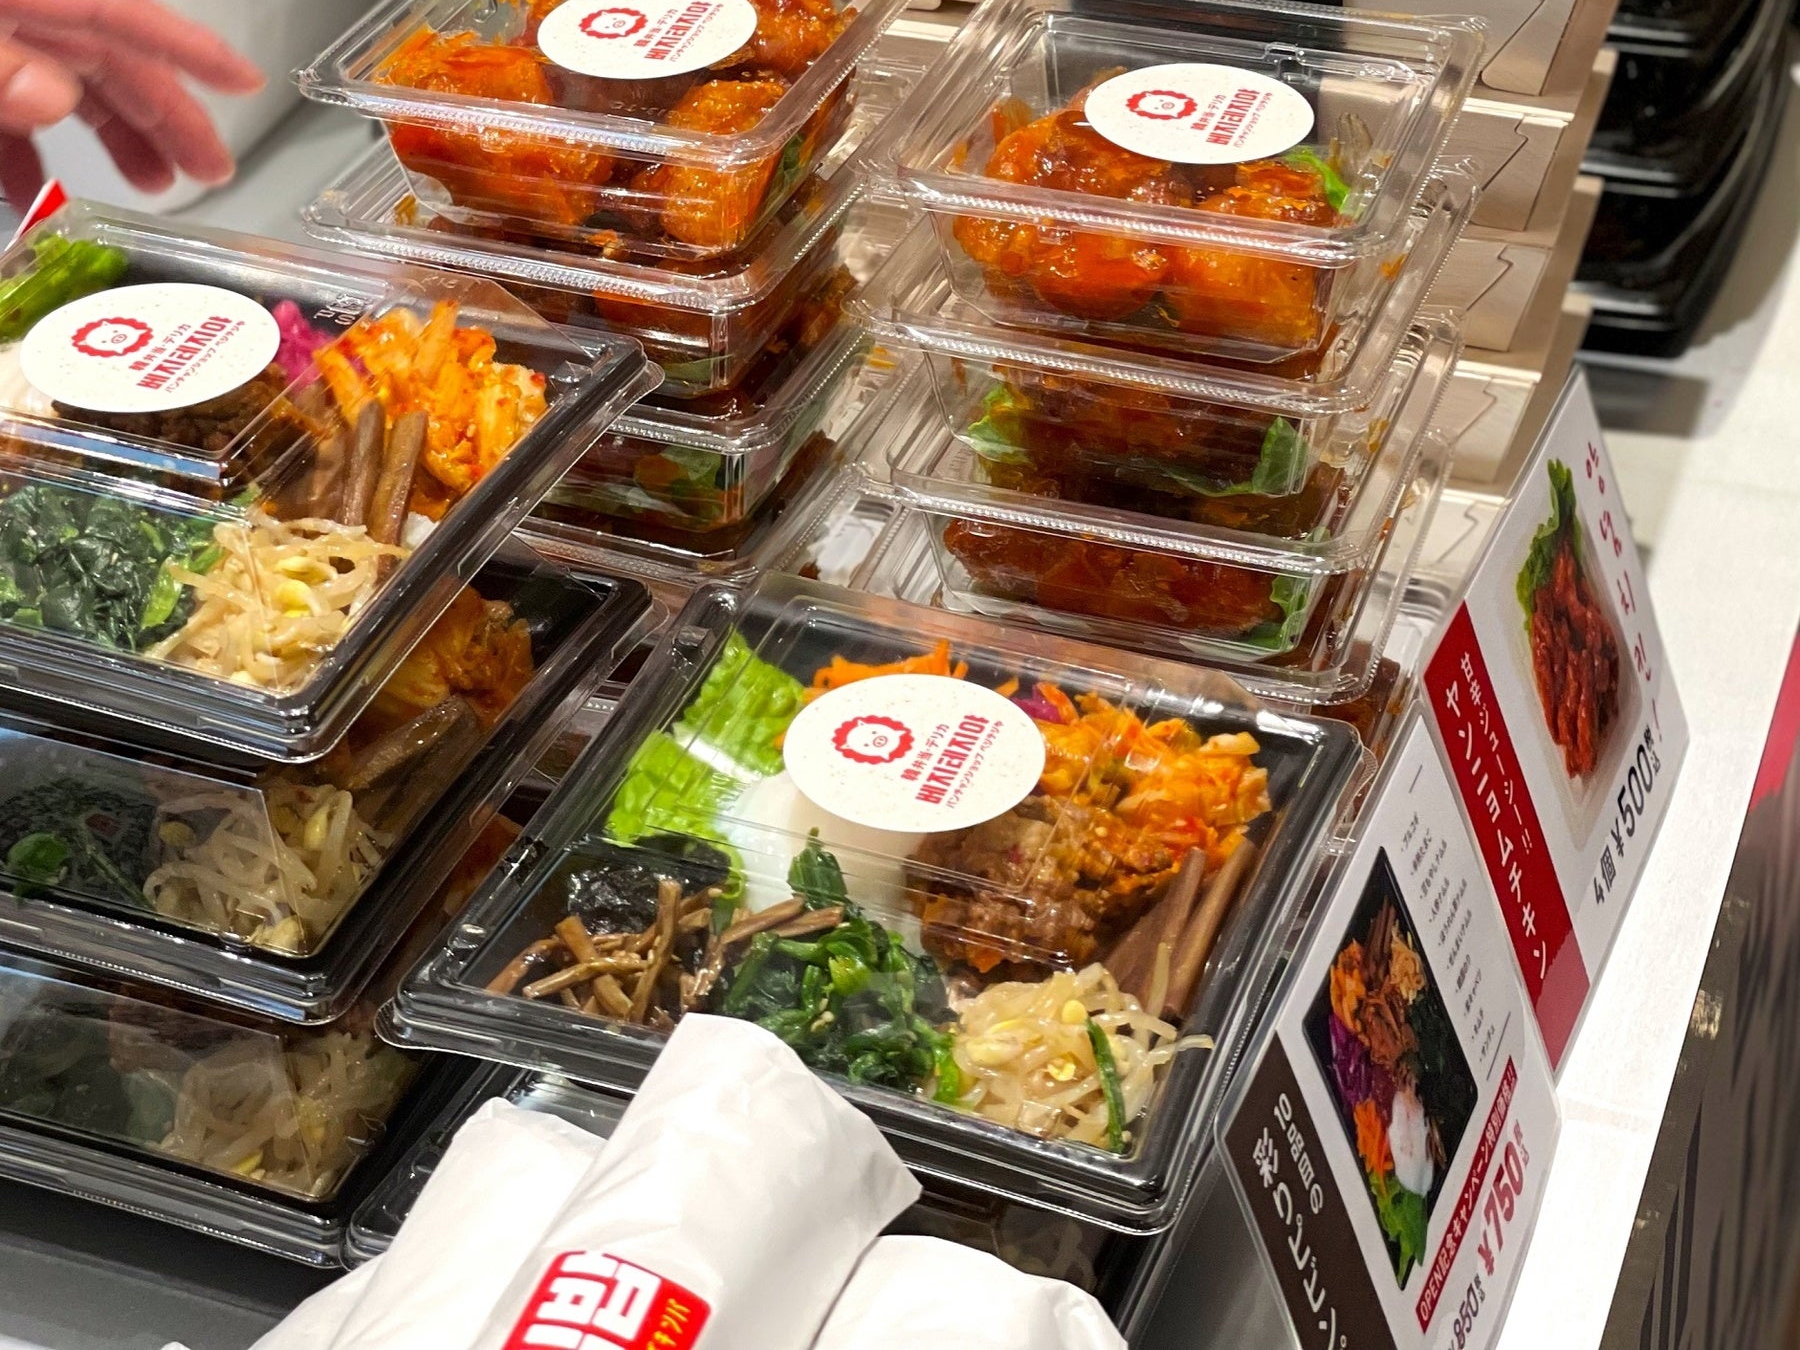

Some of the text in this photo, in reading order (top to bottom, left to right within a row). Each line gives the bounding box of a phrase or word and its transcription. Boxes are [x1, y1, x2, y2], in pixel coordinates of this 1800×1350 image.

[1446, 680, 1547, 980] ヤンニョムチキン
[1460, 651, 1533, 855] 甘辛ジューシー!!
[1273, 1092, 1324, 1215] 10品目の
[520, 1250, 662, 1350] 밥
[1252, 1126, 1348, 1350] 彩りピビン
[646, 1297, 692, 1350] キンパ
